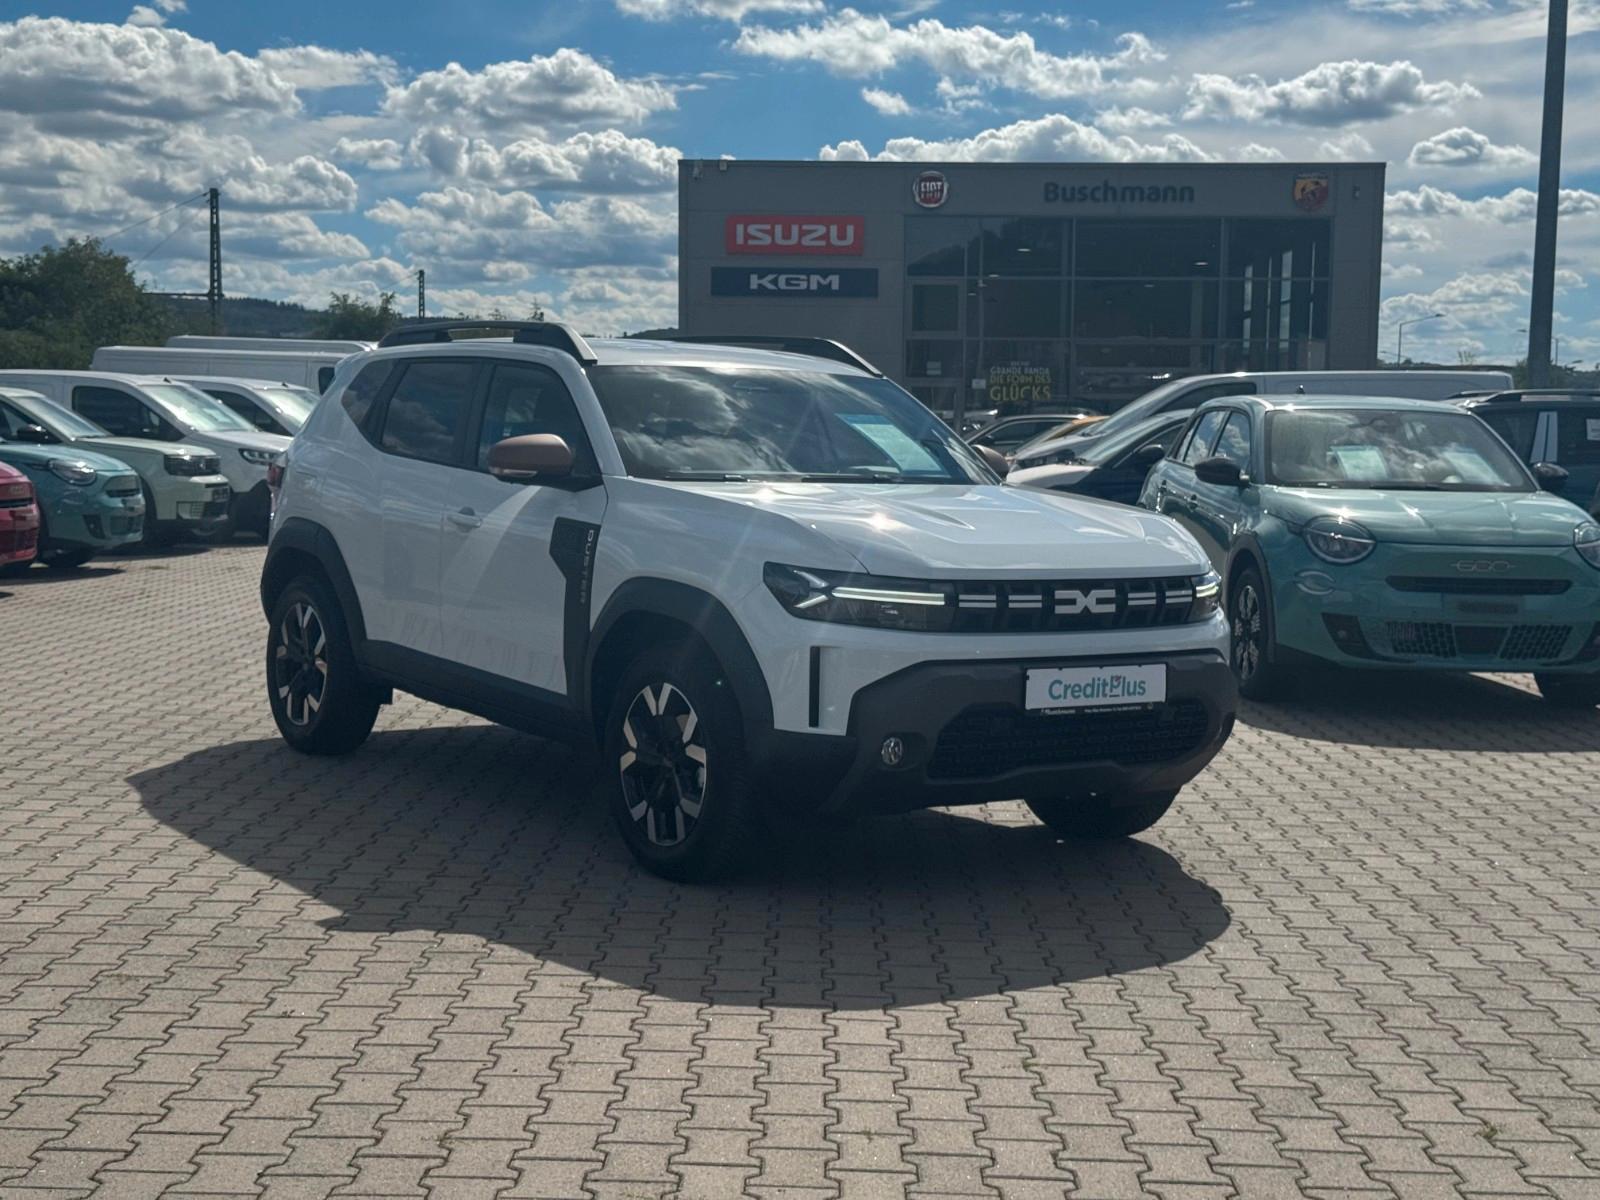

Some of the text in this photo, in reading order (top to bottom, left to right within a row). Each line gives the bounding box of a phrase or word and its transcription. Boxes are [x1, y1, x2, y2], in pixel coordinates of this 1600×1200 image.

[1044, 181, 1194, 204] Buschmann
[736, 224, 855, 246] ISUZU
[749, 274, 840, 291] KGM
[1048, 674, 1147, 701] CreditPlus
